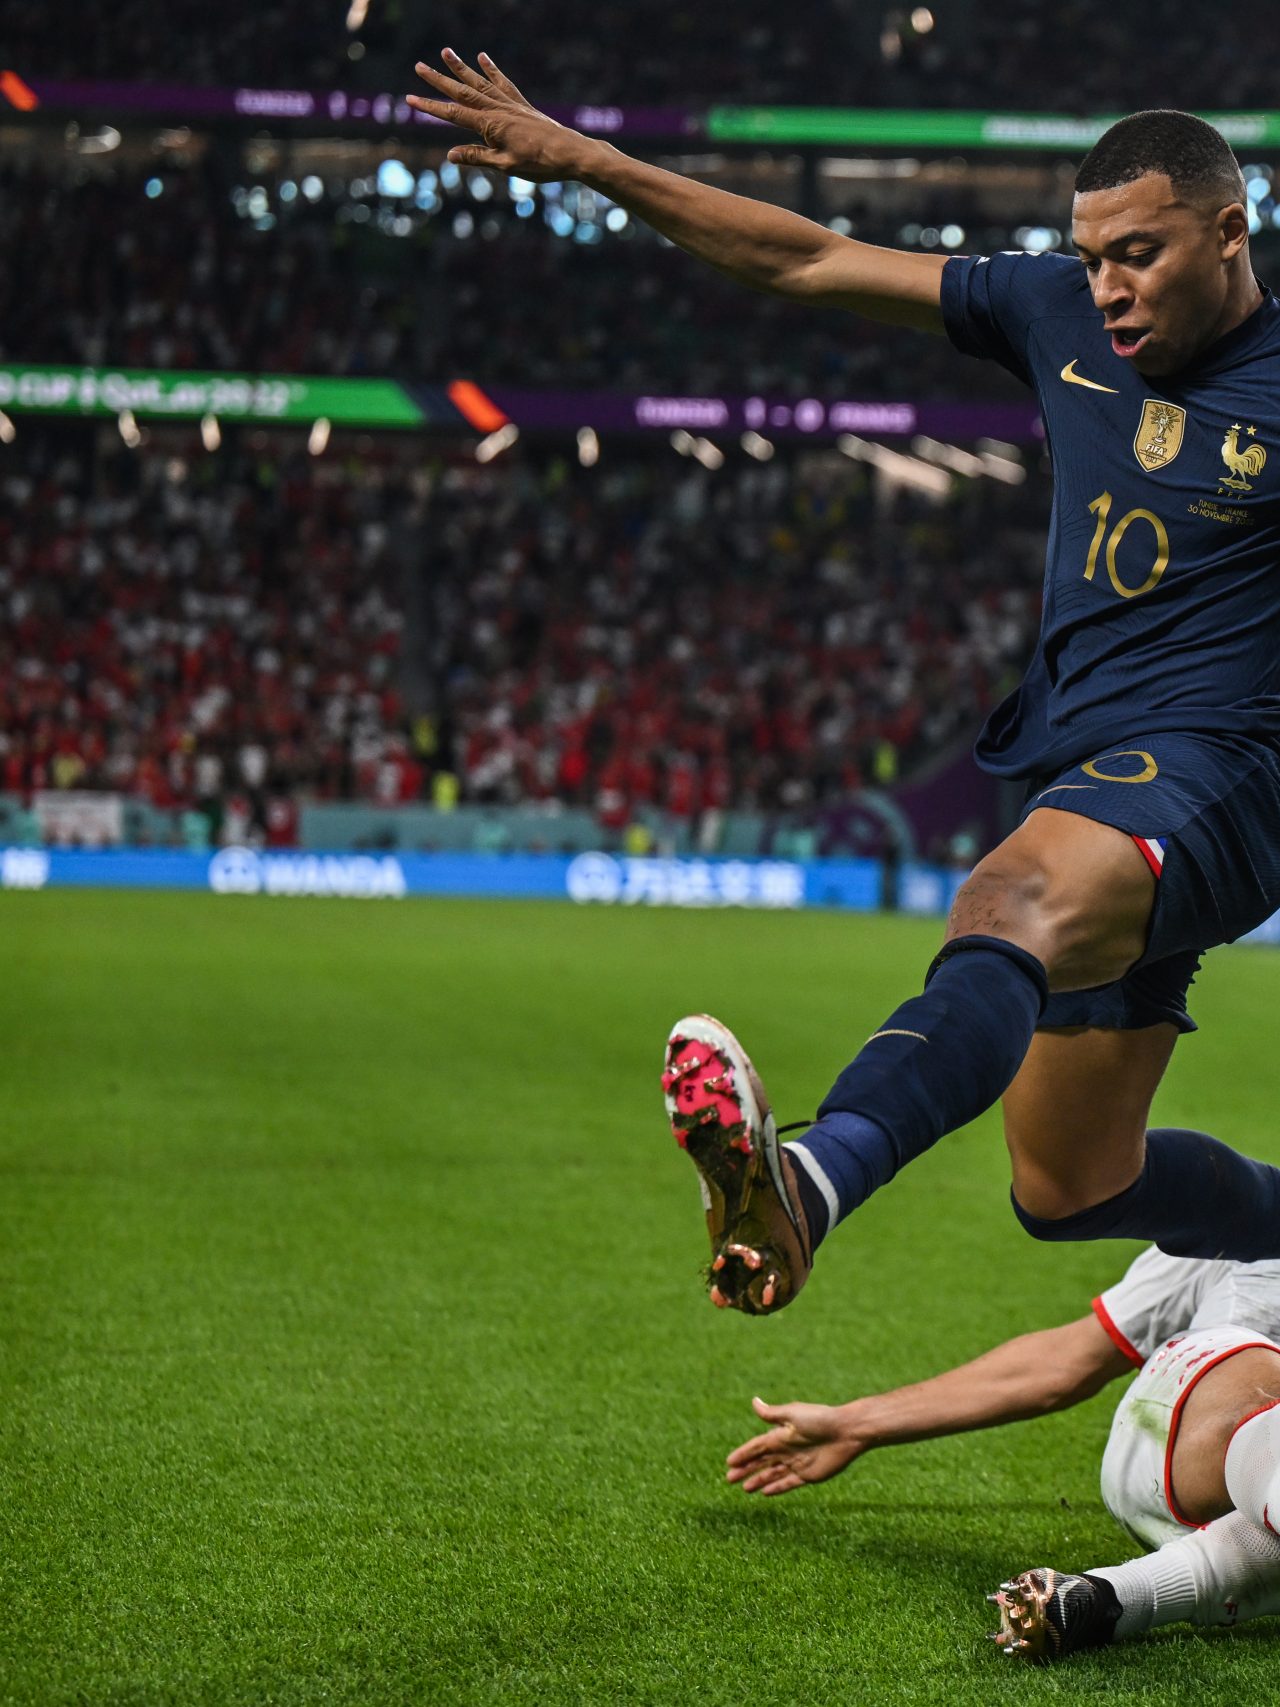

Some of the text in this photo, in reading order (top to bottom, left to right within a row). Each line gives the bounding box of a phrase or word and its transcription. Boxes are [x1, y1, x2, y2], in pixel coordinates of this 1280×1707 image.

[1145, 443, 1165, 457] FIFA
[1187, 504, 1198, 514] 30
[1199, 508, 1233, 524] NOVEMBRE
[1083, 490, 1170, 599] 10
